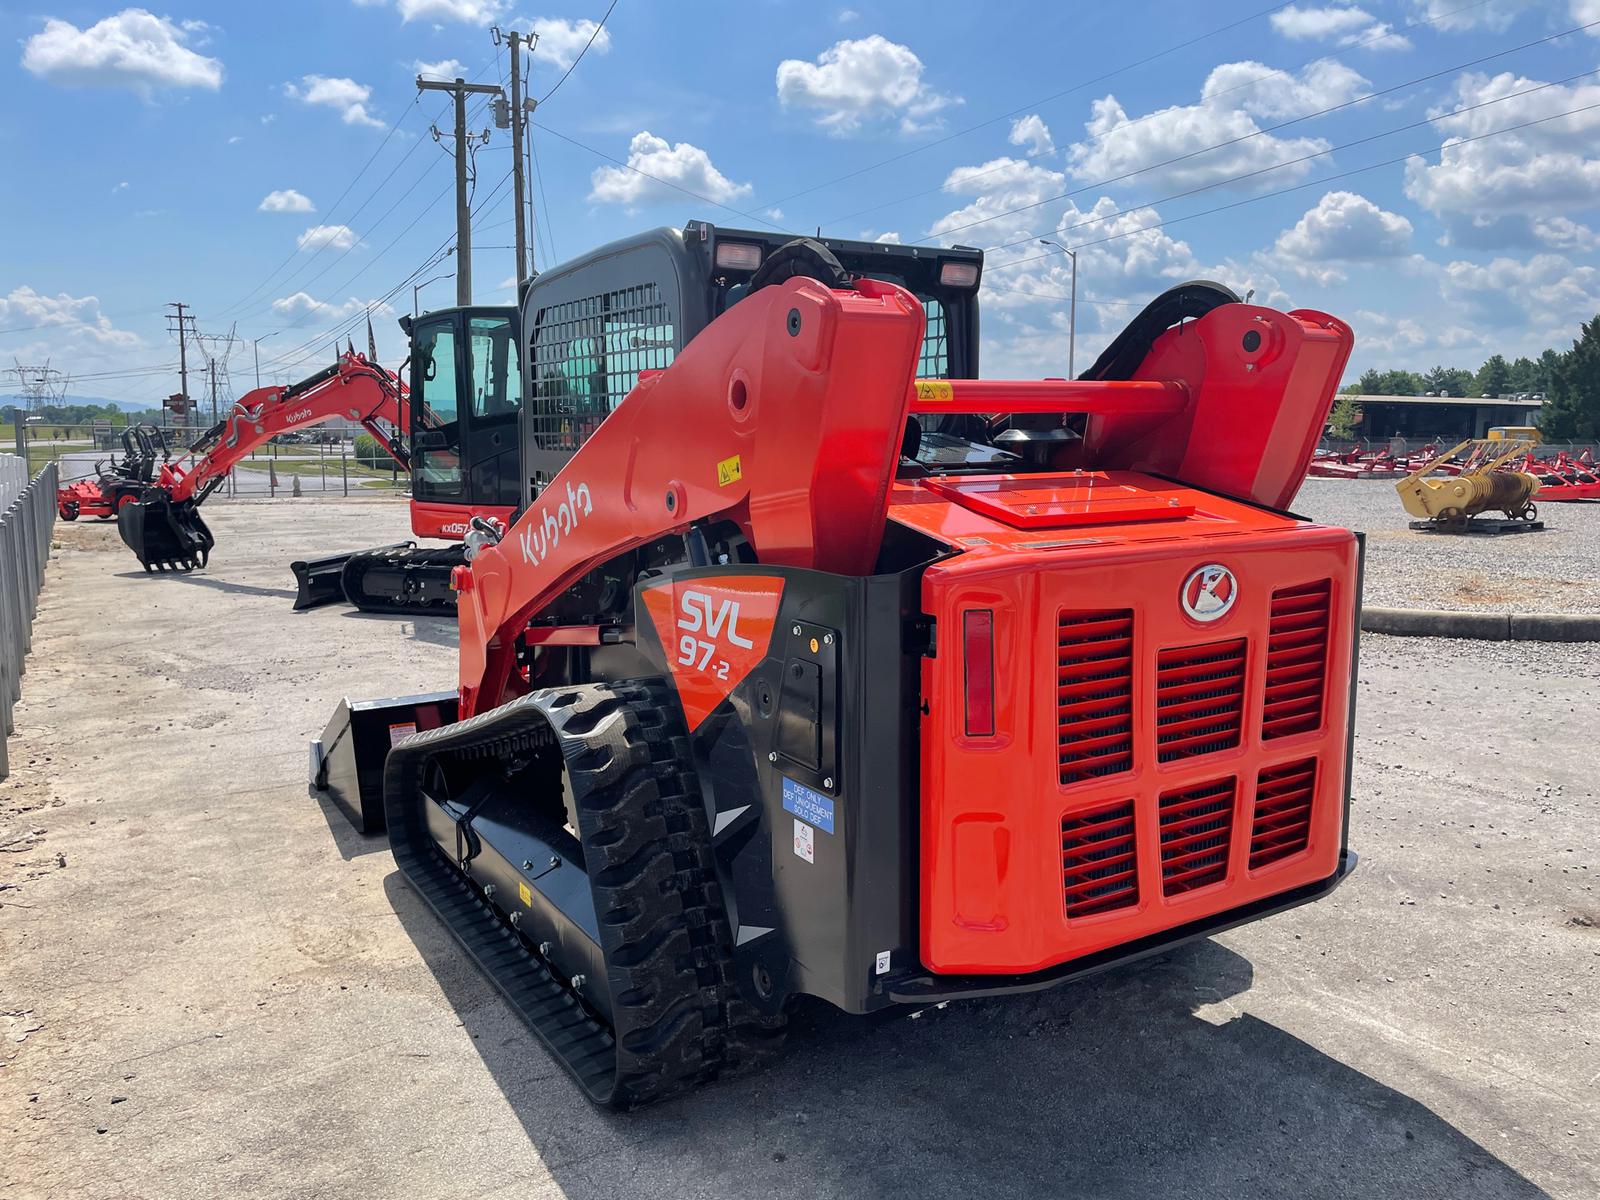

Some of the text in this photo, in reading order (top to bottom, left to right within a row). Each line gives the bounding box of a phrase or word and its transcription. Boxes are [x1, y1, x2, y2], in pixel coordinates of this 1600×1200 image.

[286, 409, 312, 423] Kubota
[520, 481, 593, 567] Kubota
[677, 590, 754, 650] SVL
[783, 789, 794, 800] DEF
[794, 784, 821, 805] DEF ONLY
[794, 804, 821, 824] SOLO DEF
